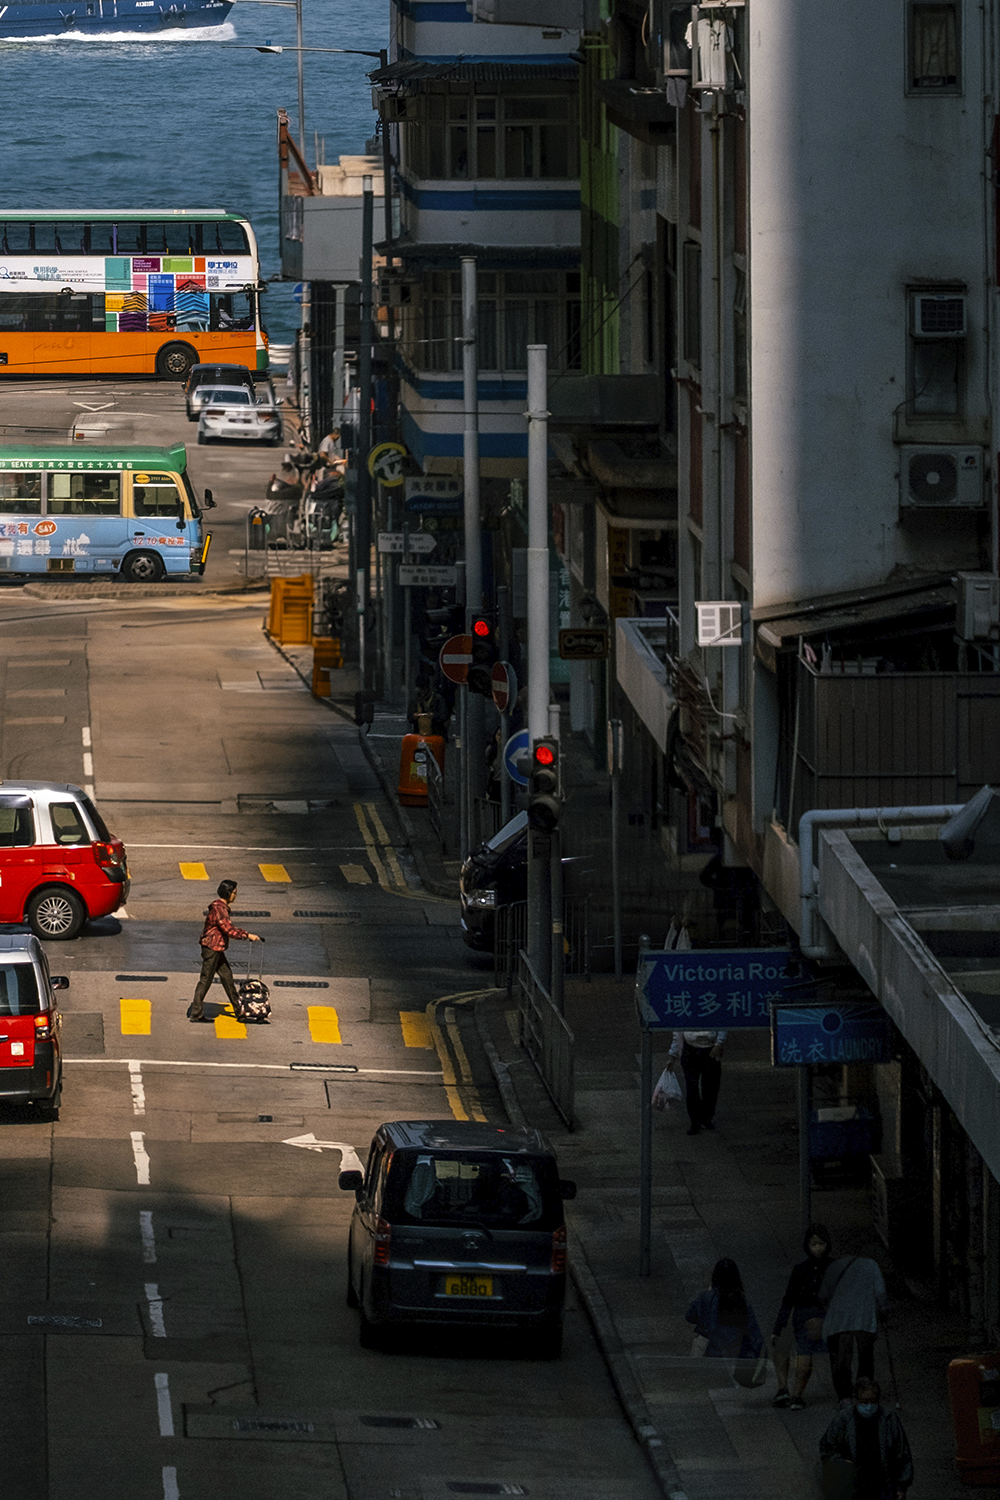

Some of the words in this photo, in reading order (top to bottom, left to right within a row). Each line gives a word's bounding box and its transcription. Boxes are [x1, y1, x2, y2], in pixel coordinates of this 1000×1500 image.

[38, 525, 54, 533] SAY
[664, 964, 744, 982] Victoria
[664, 990, 783, 1018] 域多利道
[781, 1038, 828, 1063] 洗衣
